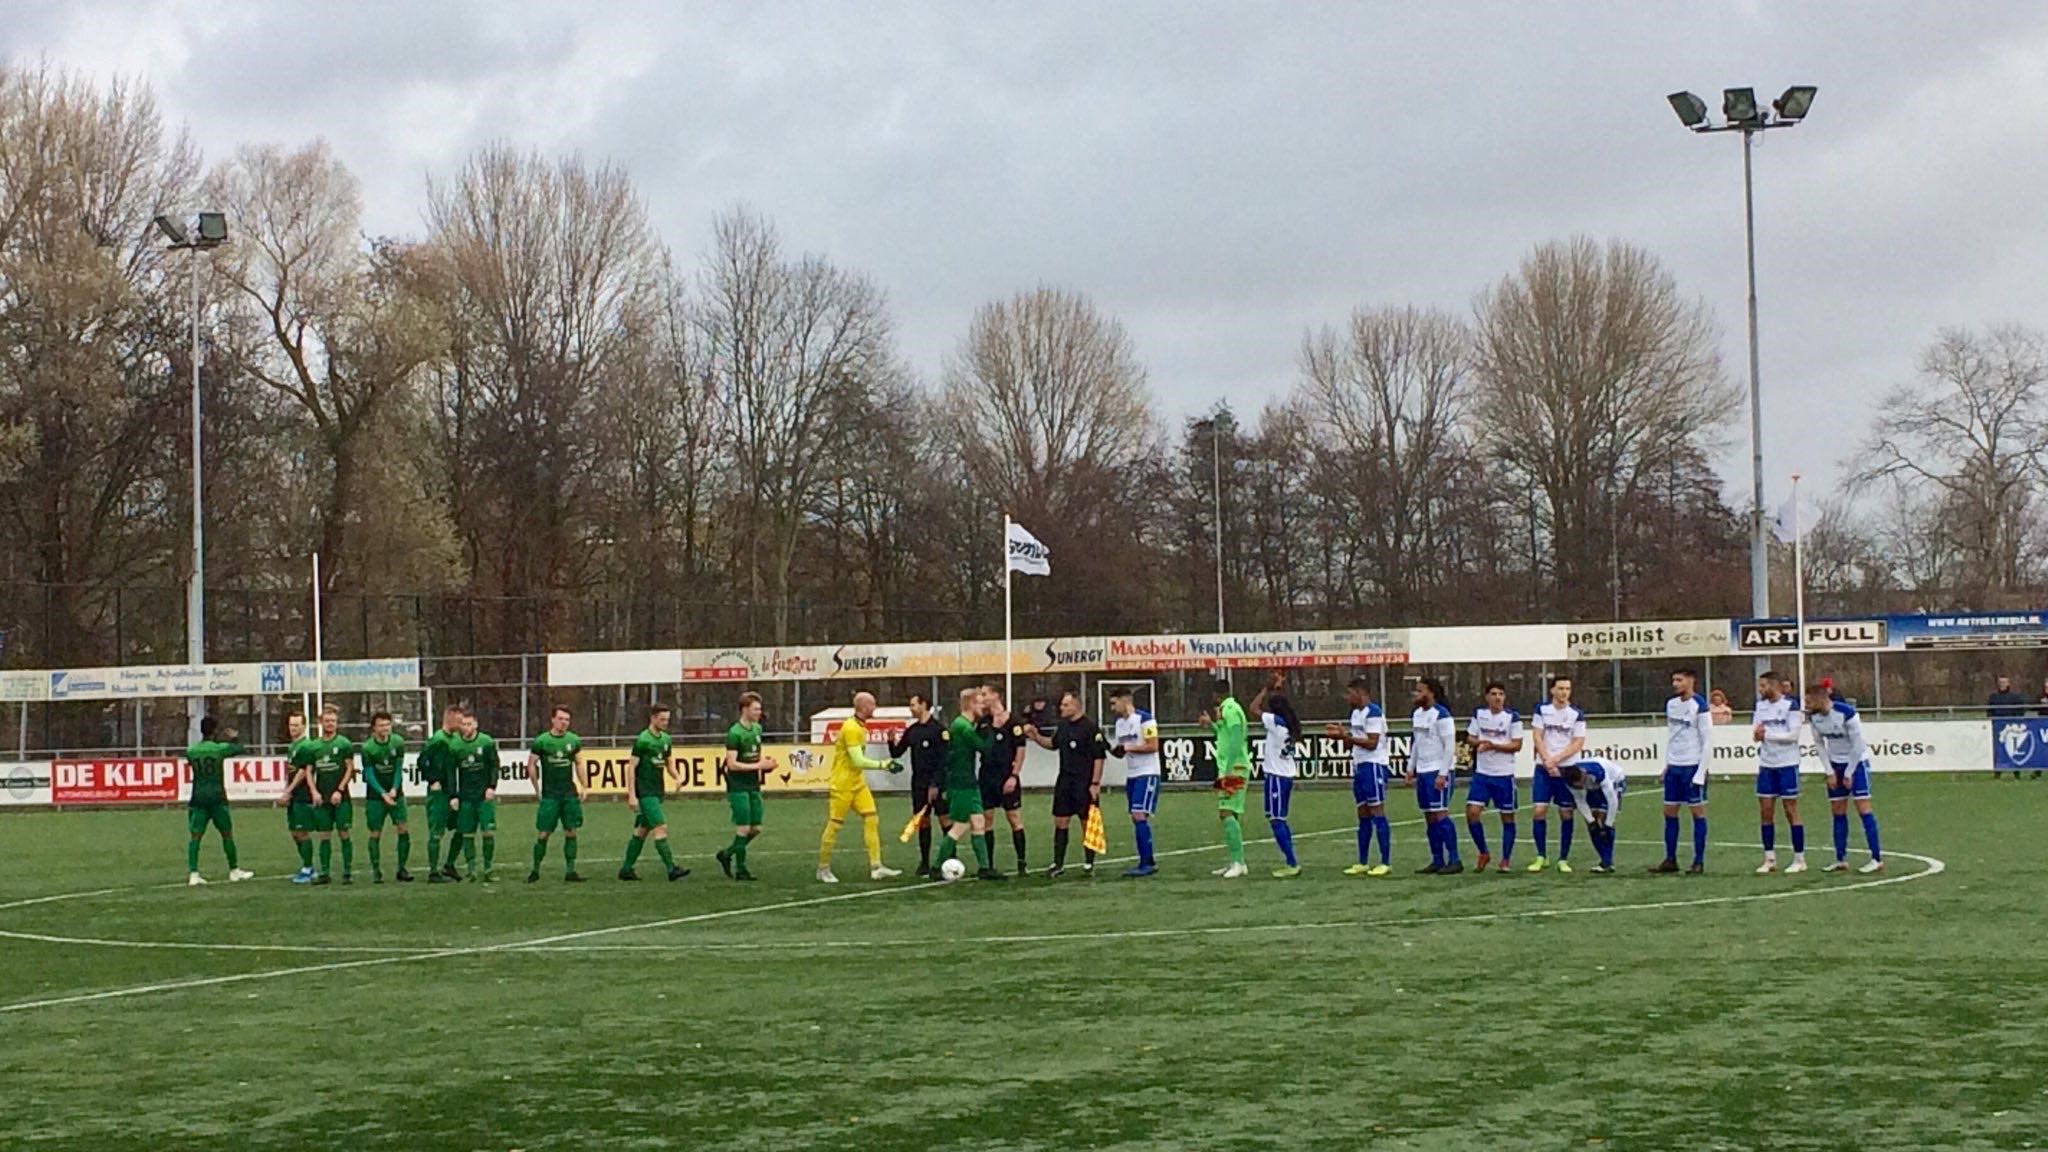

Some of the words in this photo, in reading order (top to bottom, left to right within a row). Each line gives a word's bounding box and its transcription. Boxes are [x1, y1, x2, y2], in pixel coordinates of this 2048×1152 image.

[1298, 636, 1316, 650] bv
[1567, 627, 1664, 648] pecialist
[1745, 628, 1798, 644] ART
[1808, 627, 1874, 641] FULL
[832, 645, 889, 677] SUNERGY
[1043, 637, 1104, 672] SUNERGY
[1163, 738, 1195, 761] 010
[56, 764, 95, 788] DE
[104, 762, 175, 786] KLIP
[676, 757, 705, 786] DE
